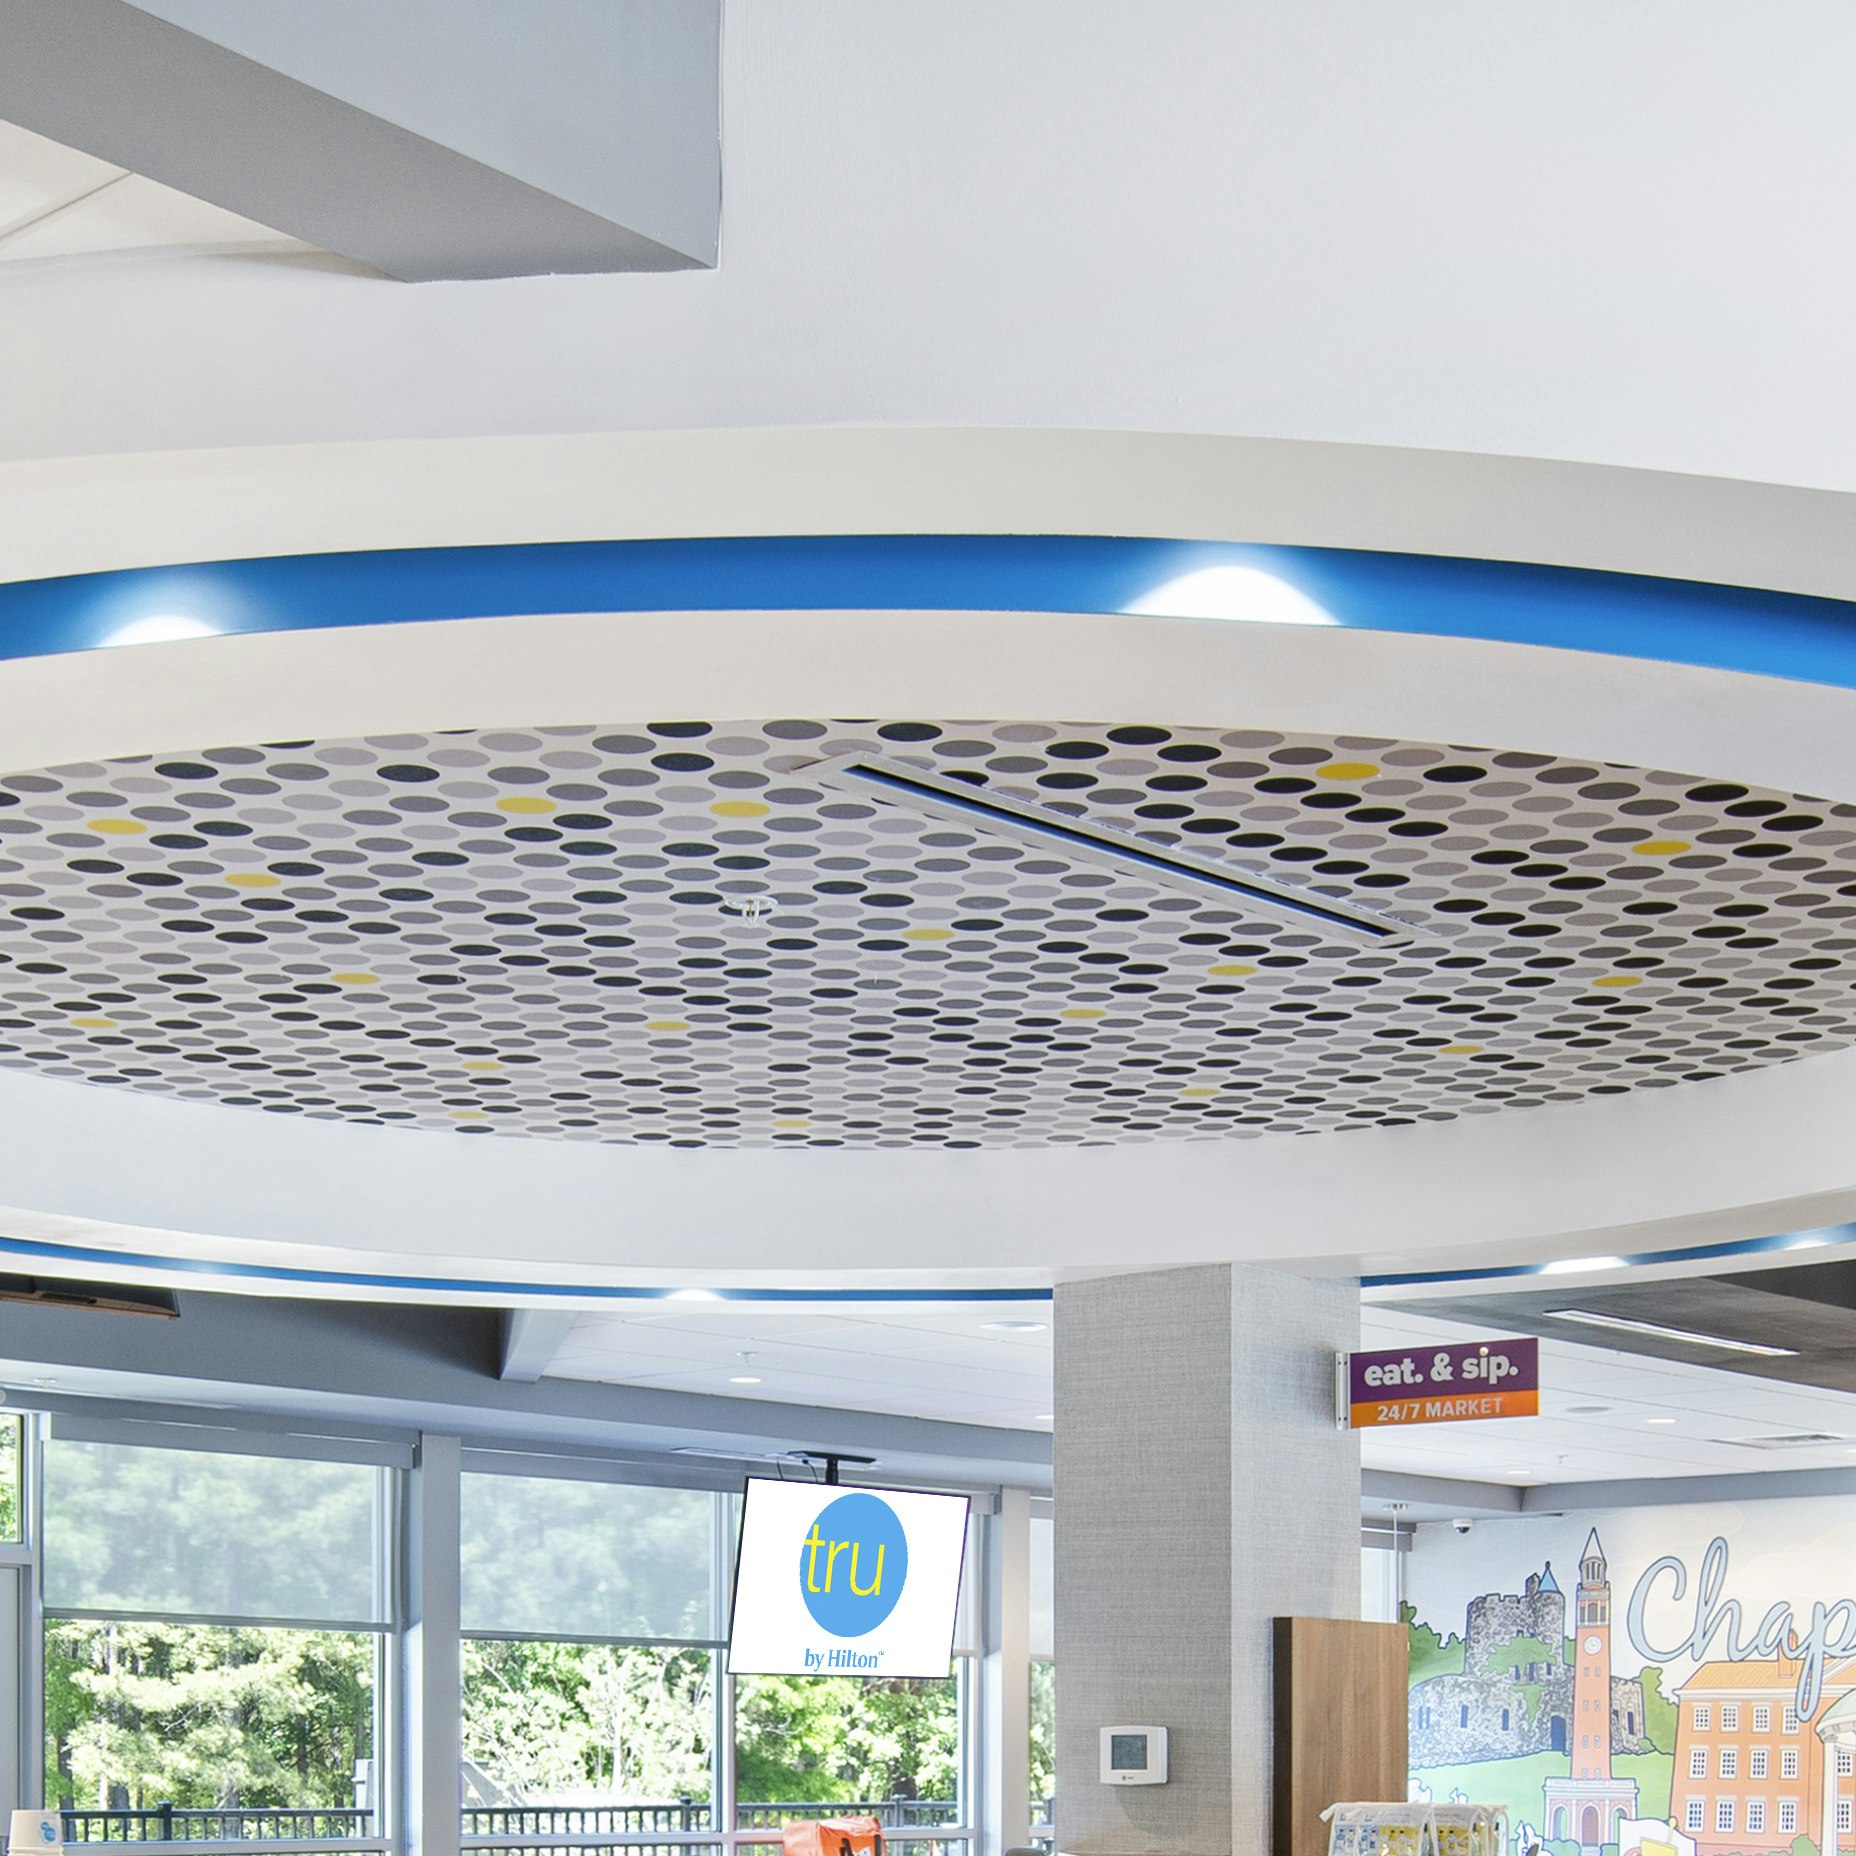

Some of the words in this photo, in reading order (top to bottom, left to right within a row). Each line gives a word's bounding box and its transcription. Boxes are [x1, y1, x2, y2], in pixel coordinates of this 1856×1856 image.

[1364, 1357, 1424, 1387] eat.
[1430, 1352, 1454, 1382] &
[1461, 1346, 1519, 1384] sip.
[1377, 1403, 1421, 1421] 24/7
[1425, 1397, 1504, 1418] MARKET
[803, 1523, 885, 1597] tru
[804, 1648, 824, 1672] by
